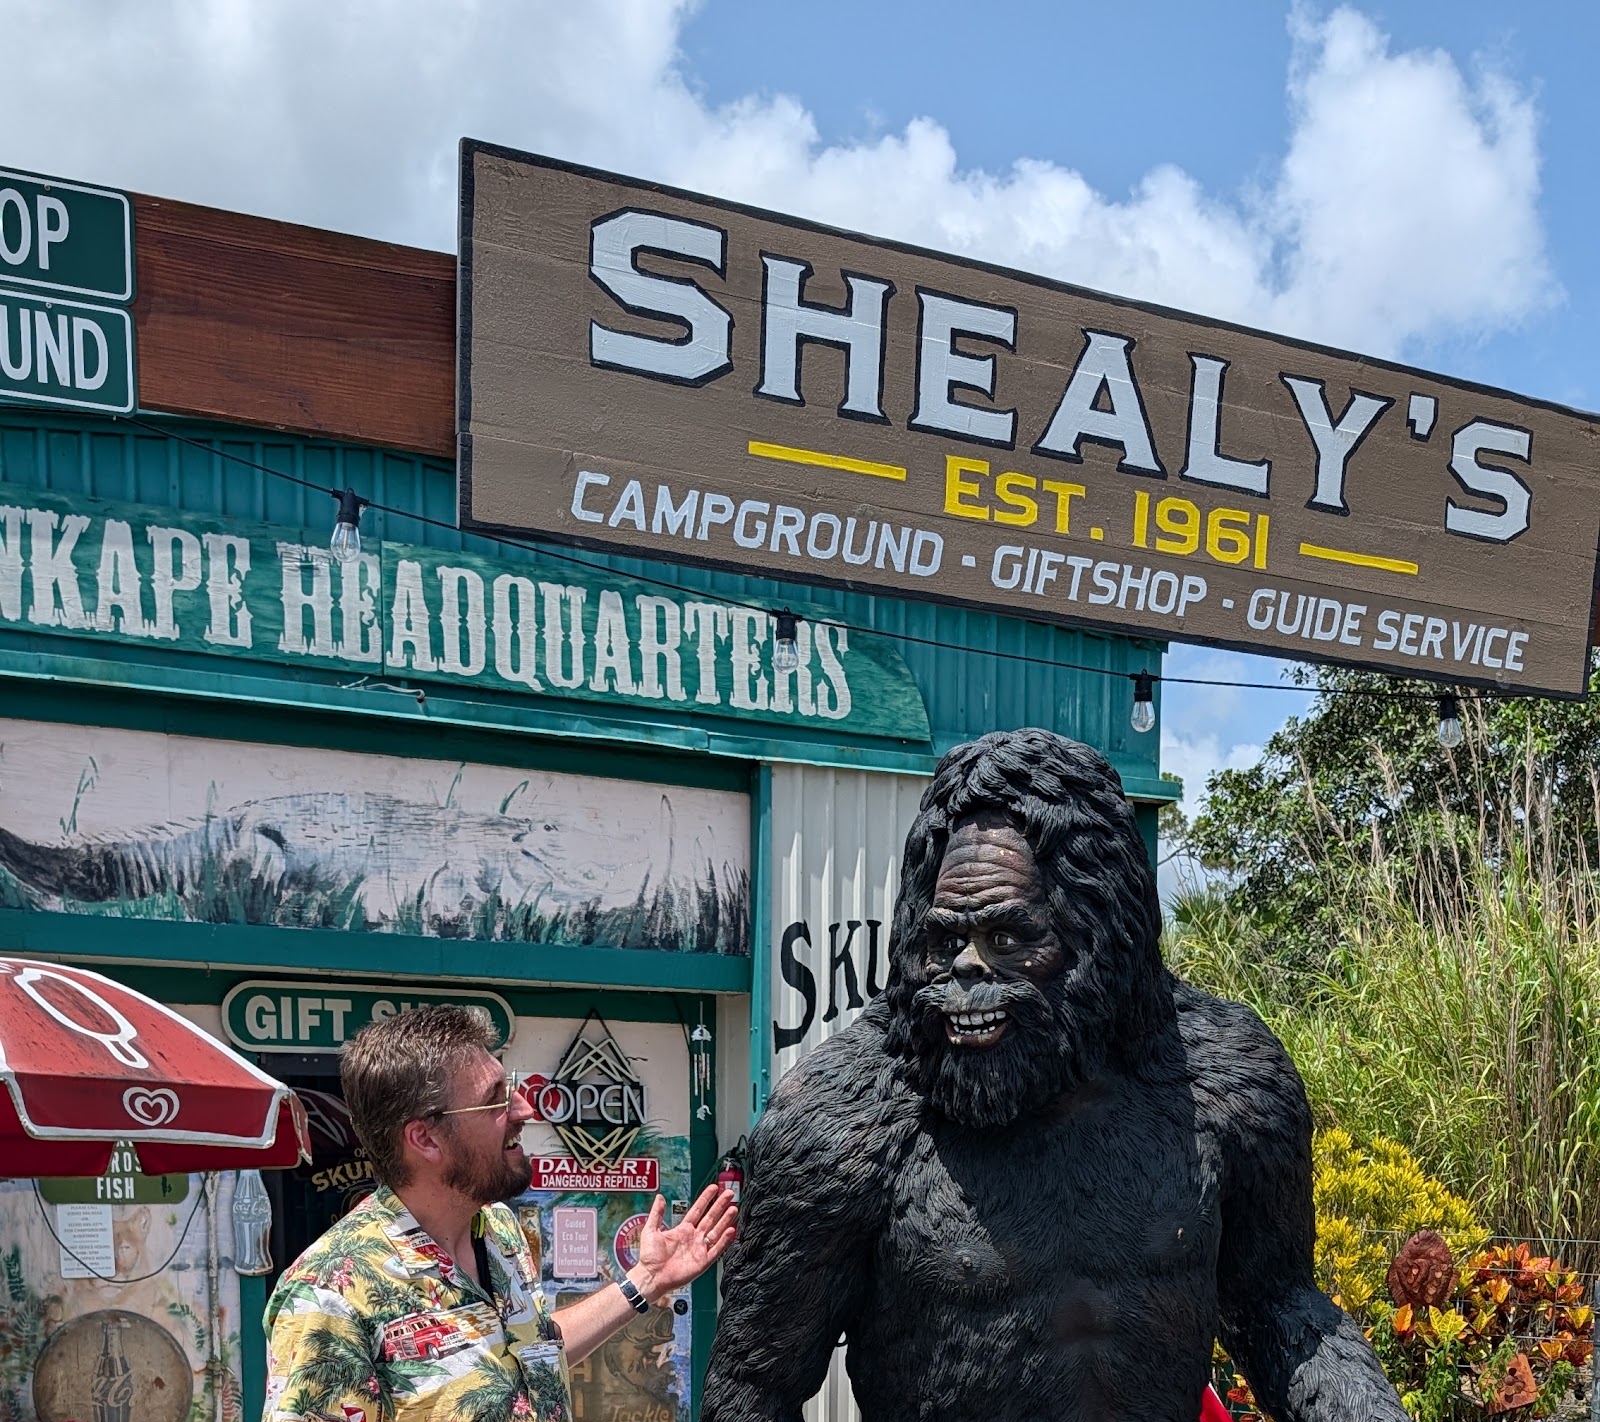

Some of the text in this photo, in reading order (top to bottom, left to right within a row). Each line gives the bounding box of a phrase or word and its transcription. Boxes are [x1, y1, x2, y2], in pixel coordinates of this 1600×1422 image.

[0, 187, 70, 271] OP
[588, 206, 1534, 545] SHEALY'S
[943, 455, 1270, 570] EST. 1961
[570, 470, 1531, 672] CAMPGROUND GIFTSHOP GUIDE SERVICE
[277, 541, 853, 721] HEADQUARTERS
[244, 994, 353, 1042] GIFT
[537, 1083, 649, 1125] OPEN
[96, 1176, 135, 1200] FISH
[541, 1174, 649, 1189] DANGEROUS REPTILES
[562, 1231, 589, 1241] Eco Tour
[565, 1218, 586, 1229] Guided
[619, 1217, 642, 1237] TRAIL
[558, 1256, 594, 1267] Information
[569, 1244, 589, 1254] Rental
